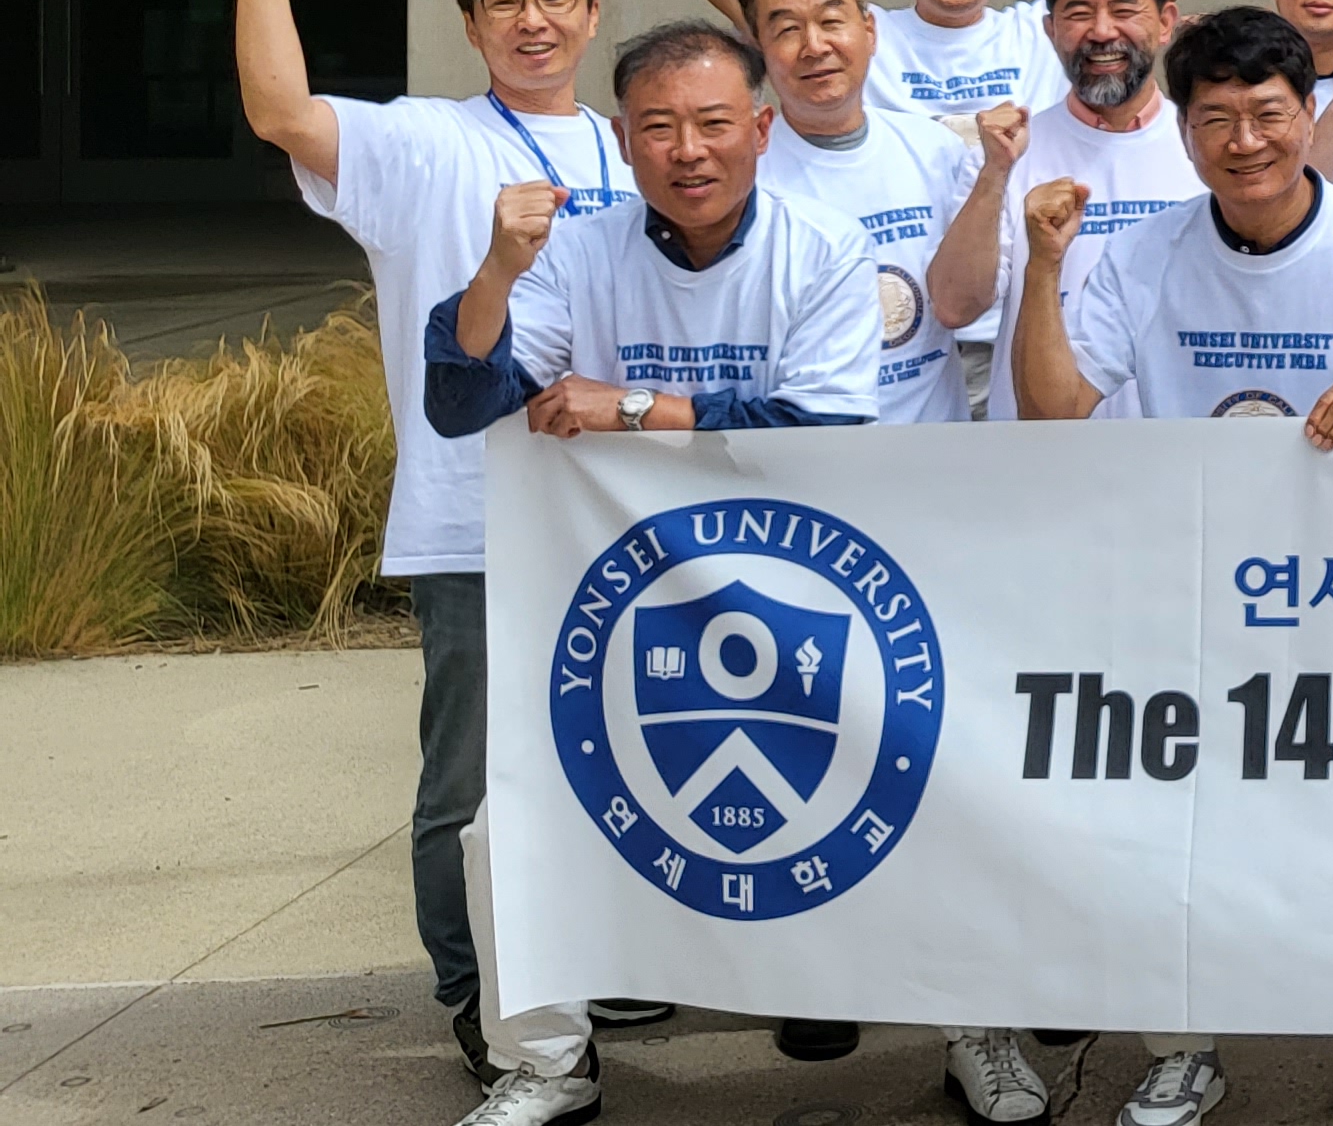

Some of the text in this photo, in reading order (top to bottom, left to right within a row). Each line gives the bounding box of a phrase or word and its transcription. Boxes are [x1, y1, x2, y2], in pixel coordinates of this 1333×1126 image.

[1178, 331, 1236, 348] YONSEI
[668, 343, 769, 363] UNIVERSITY
[1194, 351, 1327, 370] EXECUTIVE MBA
[560, 509, 933, 712] YONSEI UNIVERSITY
[1015, 672, 1200, 781] The
[711, 805, 765, 827] 1885
[603, 795, 894, 912] 연세대학교
